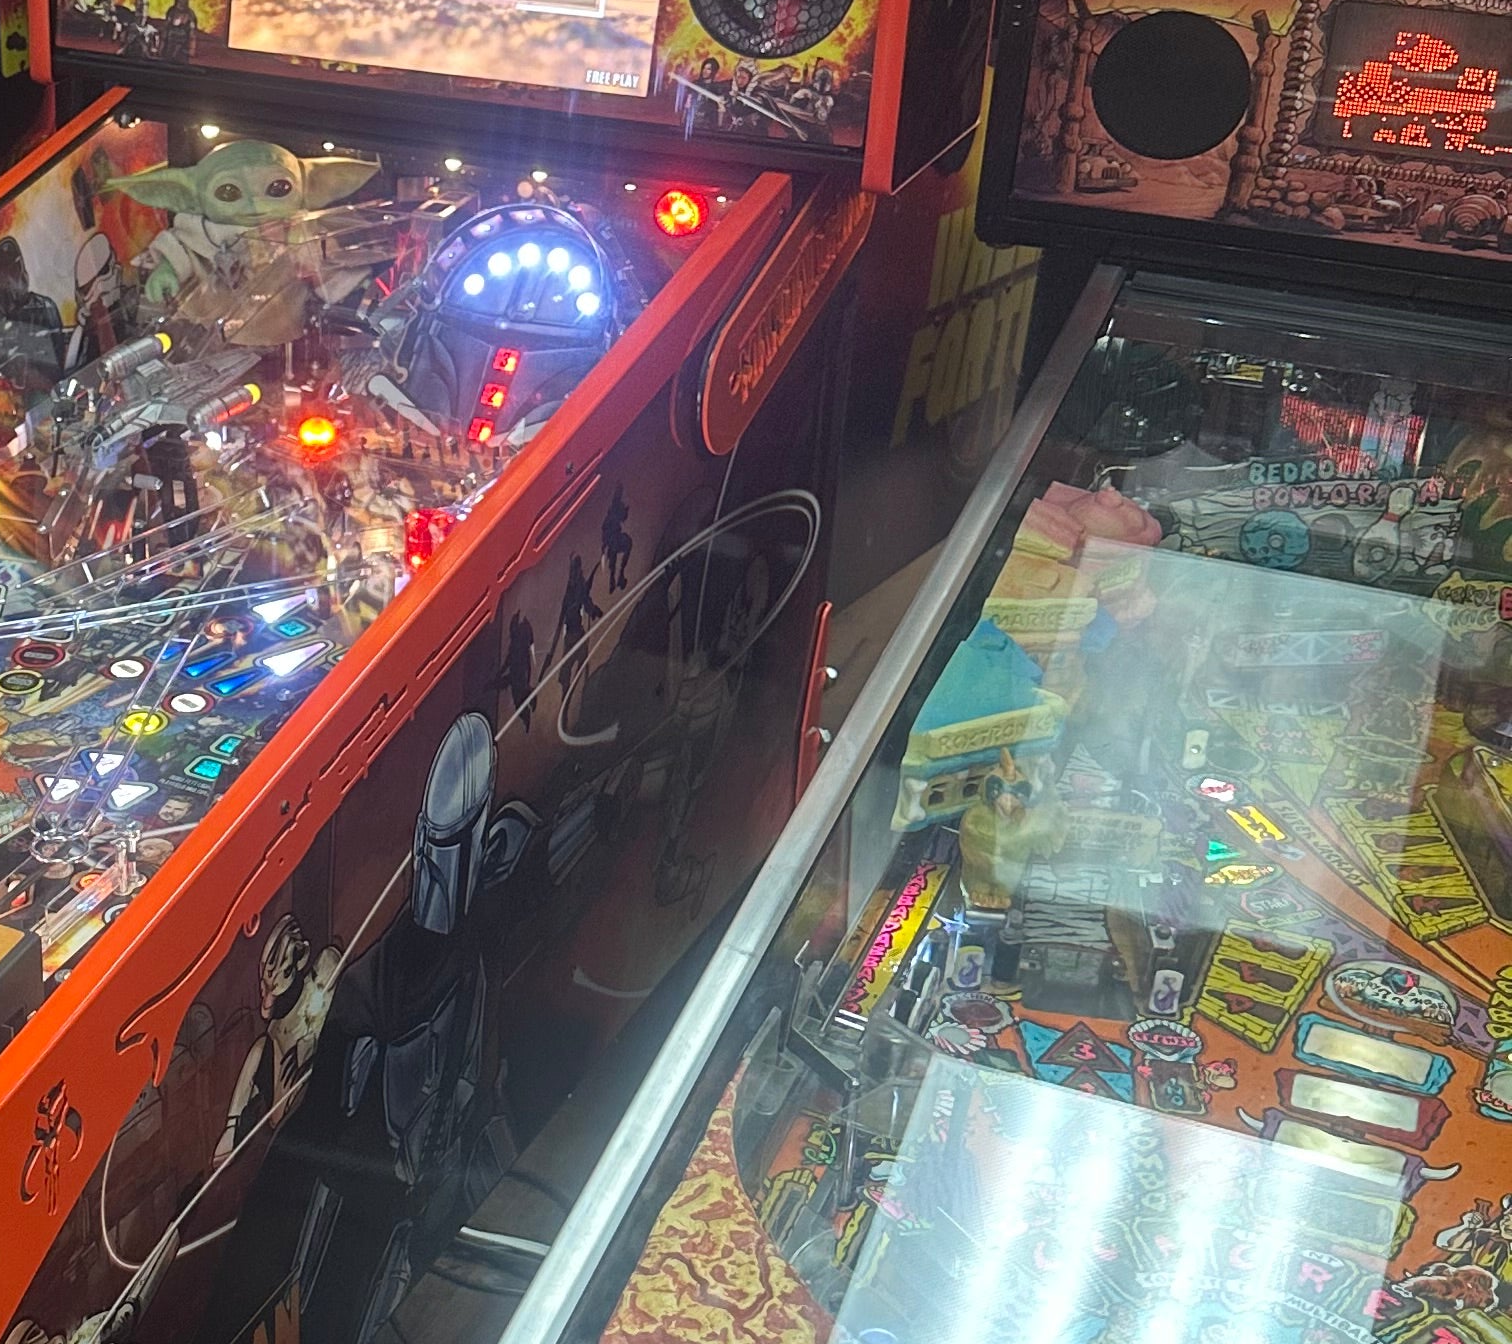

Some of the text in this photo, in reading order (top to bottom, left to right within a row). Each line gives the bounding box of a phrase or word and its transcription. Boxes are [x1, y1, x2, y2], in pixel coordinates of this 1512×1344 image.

[586, 70, 640, 90] FREE PLAY
[992, 611, 1084, 630] MARKET
